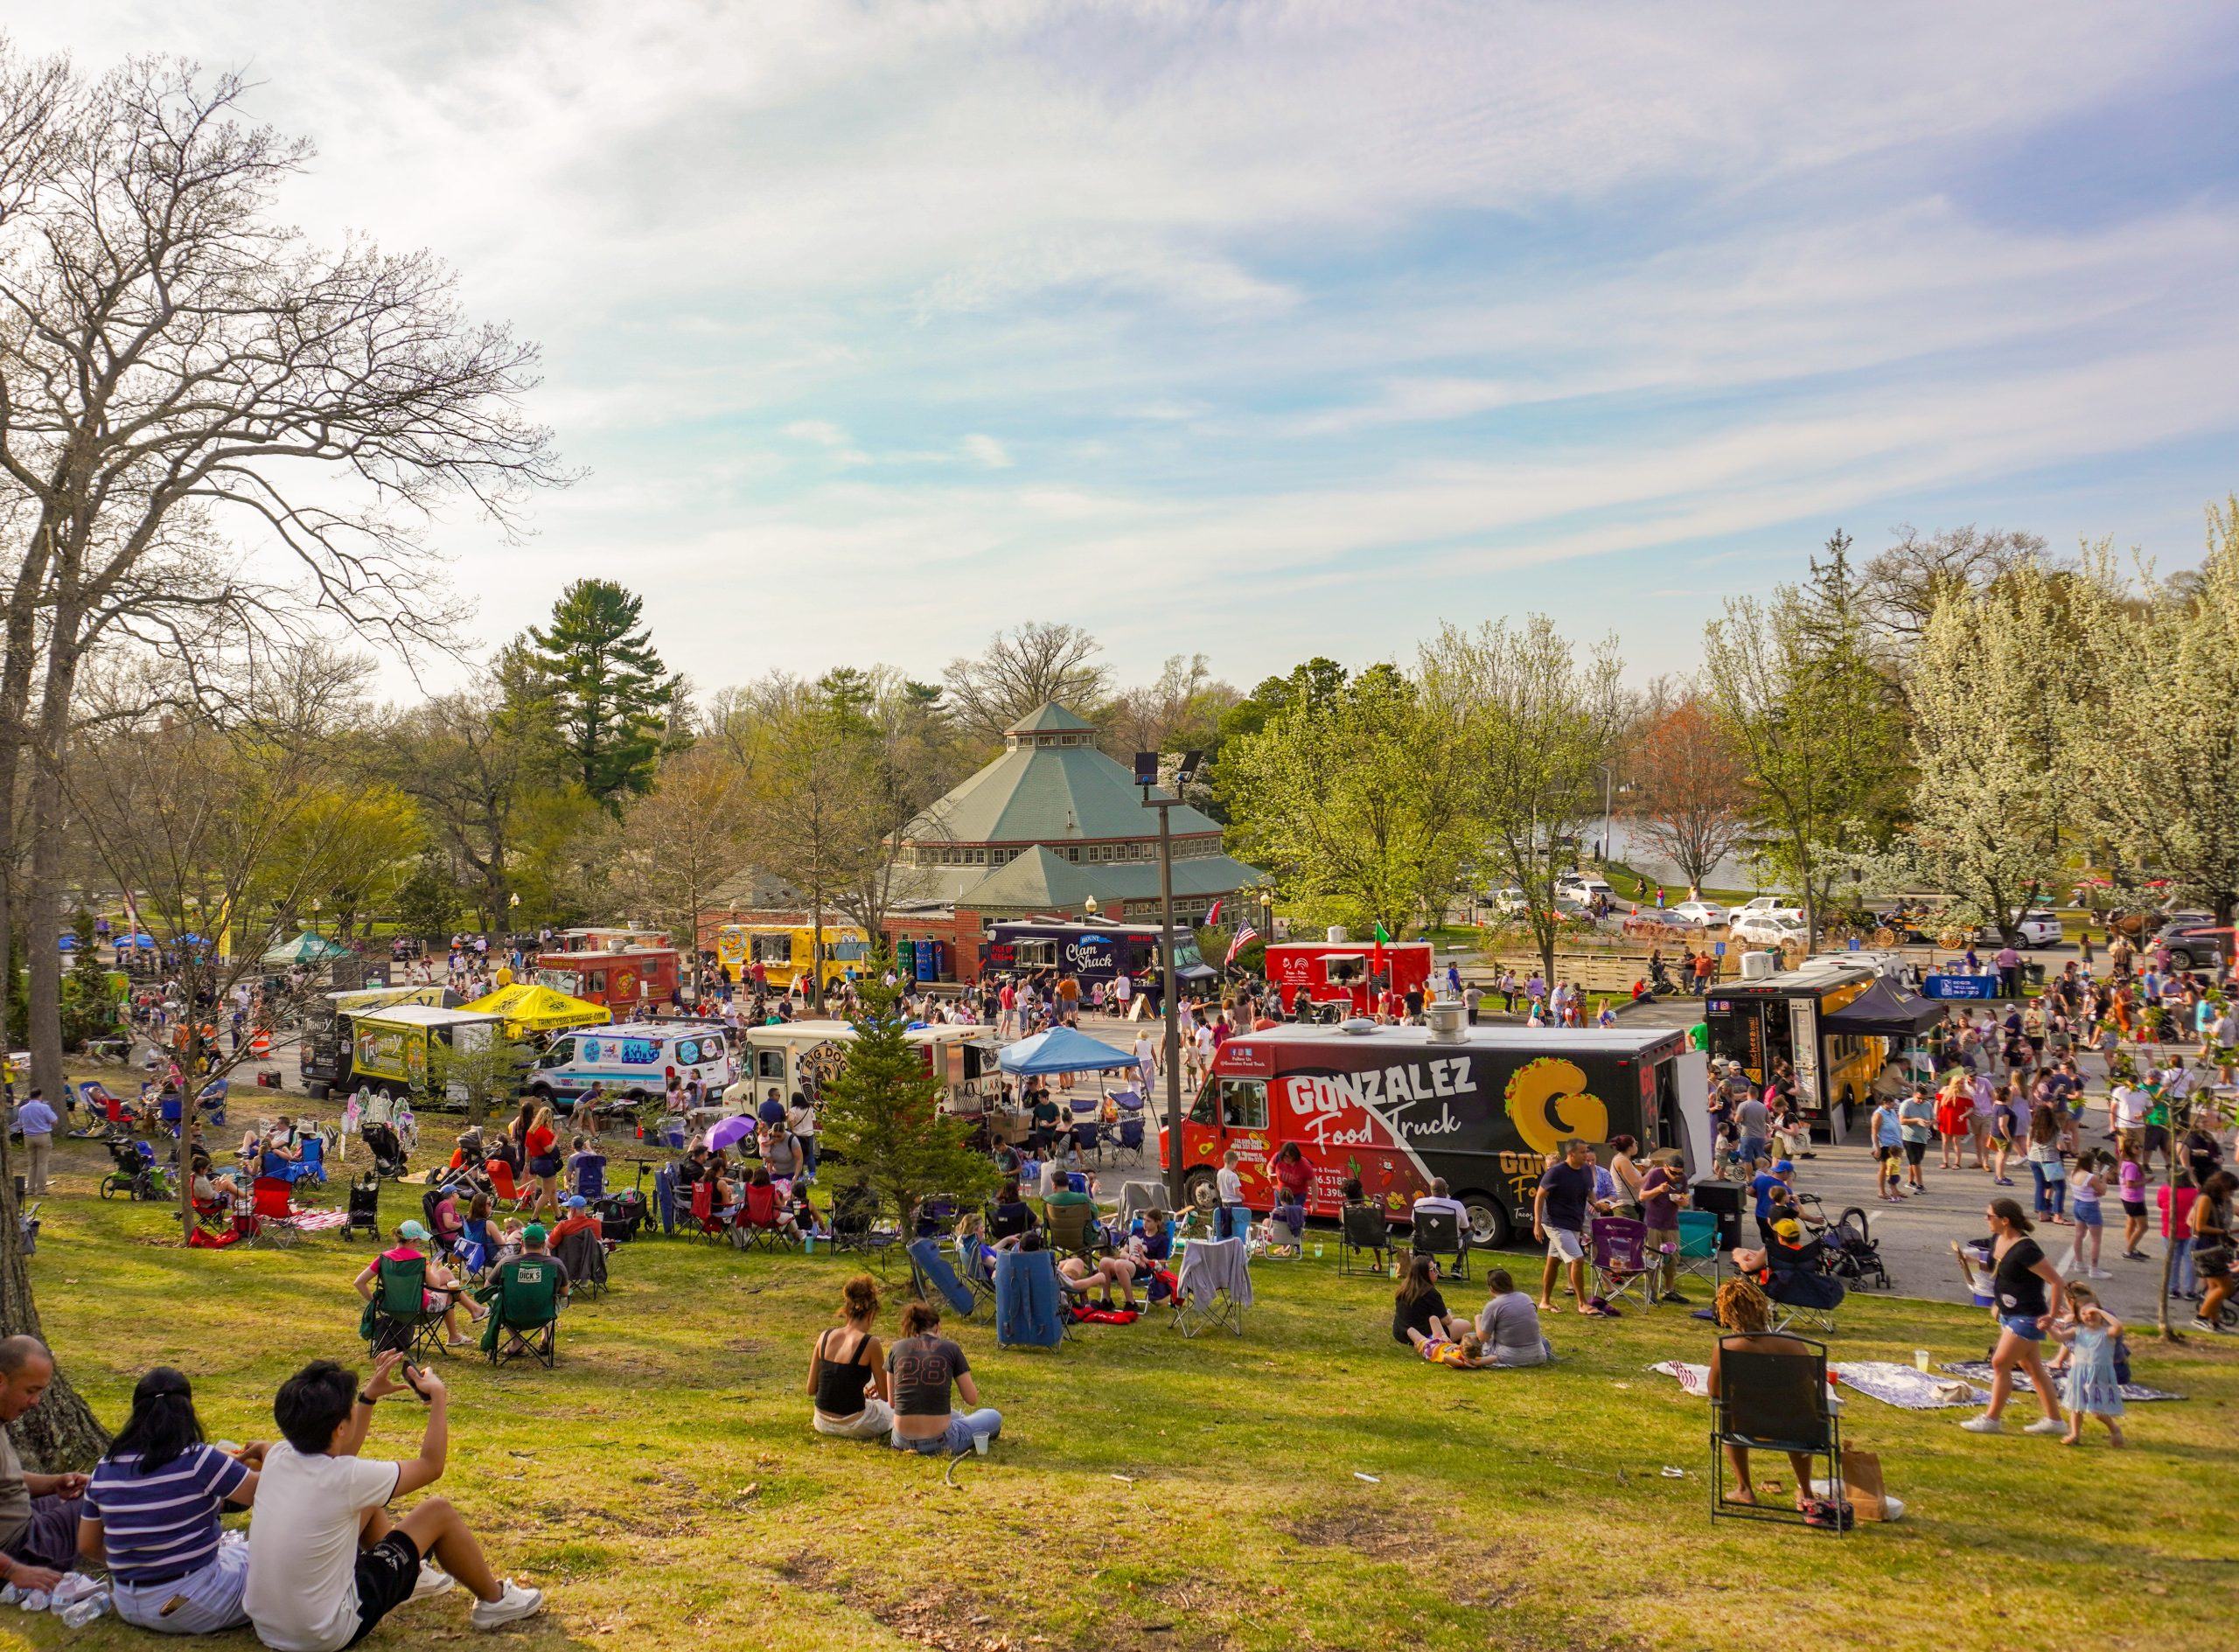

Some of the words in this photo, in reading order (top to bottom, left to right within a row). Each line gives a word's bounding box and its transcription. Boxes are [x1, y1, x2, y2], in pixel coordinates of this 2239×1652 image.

[1065, 943, 1098, 962] Clam
[1077, 953, 1113, 972] Shack
[304, 1018, 333, 1032] TRINITY
[537, 1011, 606, 1028] TRINITYBREWHOUSE.COM
[360, 1033, 402, 1063] TRINITY
[805, 1049, 822, 1070] BIG
[825, 1047, 848, 1071] DOG
[1287, 1056, 1477, 1115] GONZALEZ
[1304, 1111, 1372, 1155] Food
[1384, 1100, 1461, 1147] Truck
[1508, 1174, 1538, 1202] Fo
[1514, 1207, 1534, 1222] Tacos
[895, 1355, 947, 1387] 28
